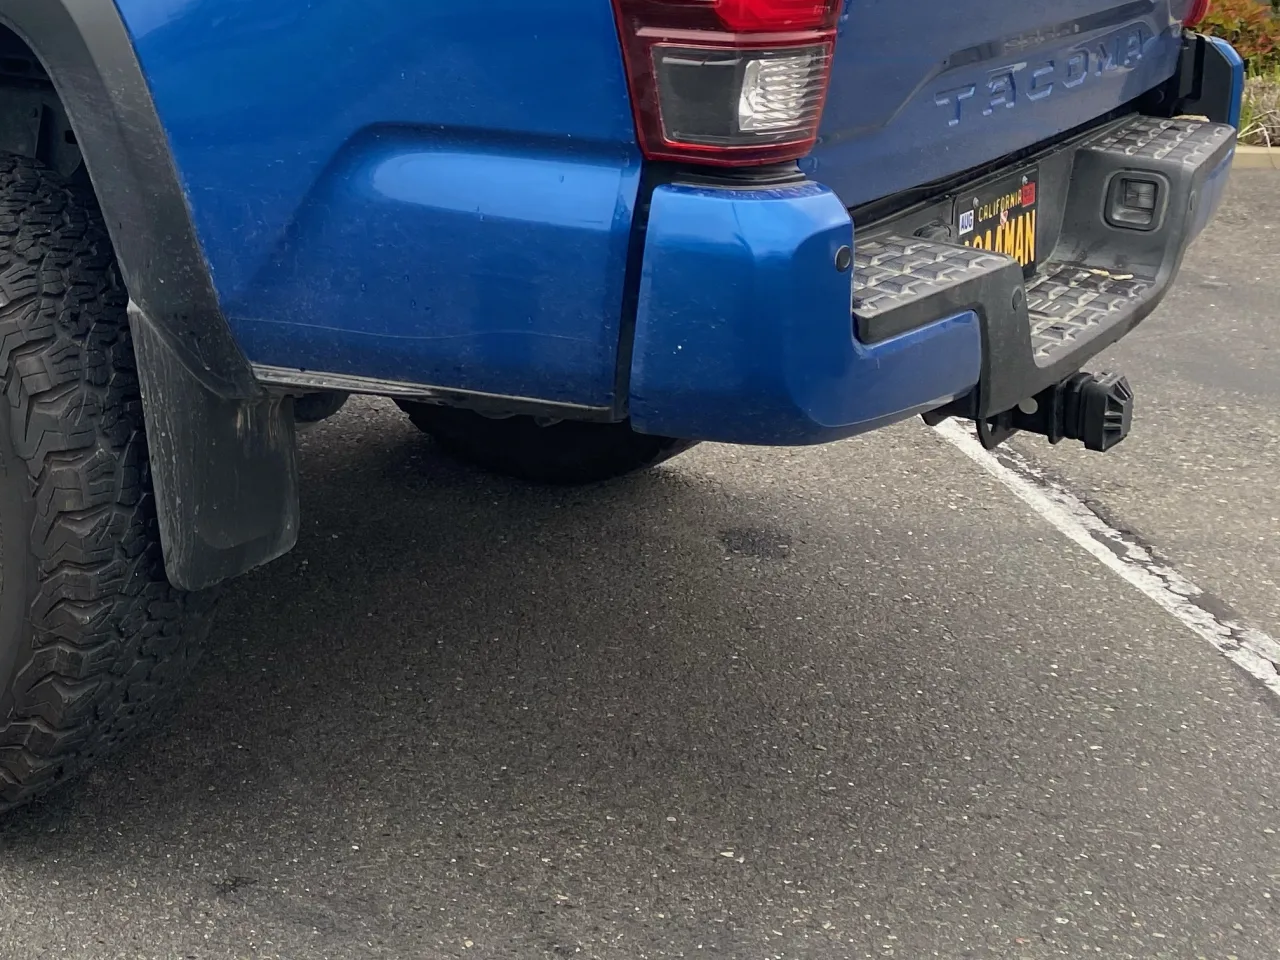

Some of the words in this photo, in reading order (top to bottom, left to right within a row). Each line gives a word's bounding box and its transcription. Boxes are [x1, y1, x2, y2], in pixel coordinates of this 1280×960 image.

[934, 28, 1143, 127] TACOMA
[960, 212, 974, 232] AUG
[978, 189, 1023, 223] CALIFORNIA
